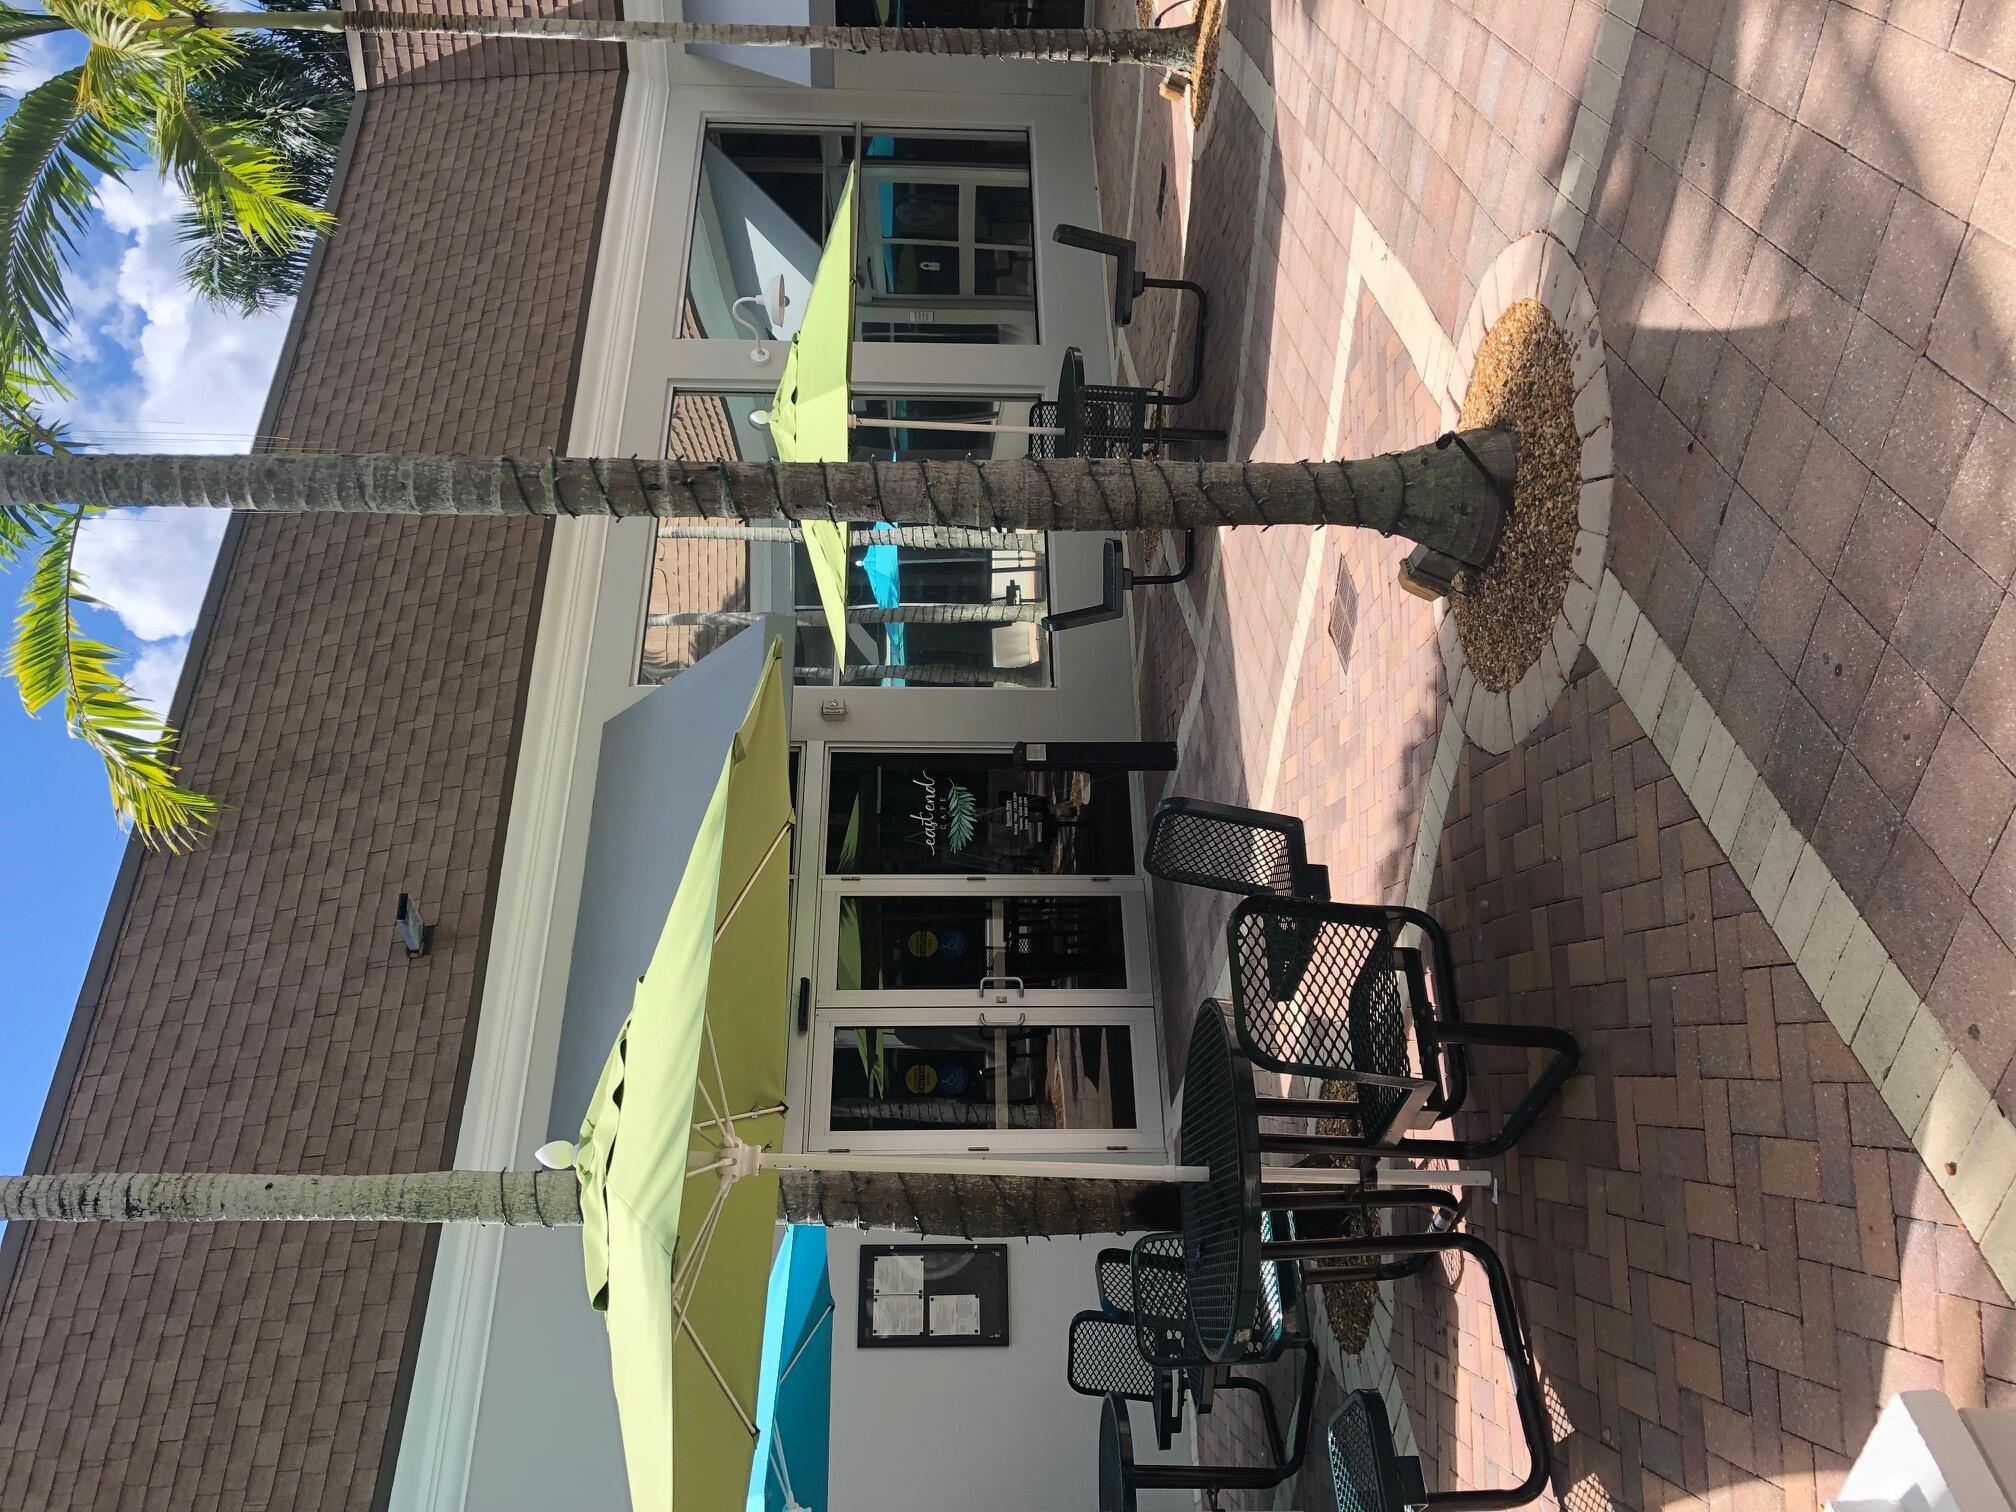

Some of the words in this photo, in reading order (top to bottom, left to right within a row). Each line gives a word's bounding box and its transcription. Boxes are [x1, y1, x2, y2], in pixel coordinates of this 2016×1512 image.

[912, 770, 936, 811] end
[939, 796, 947, 830] CAFE
[909, 811, 938, 857] east
